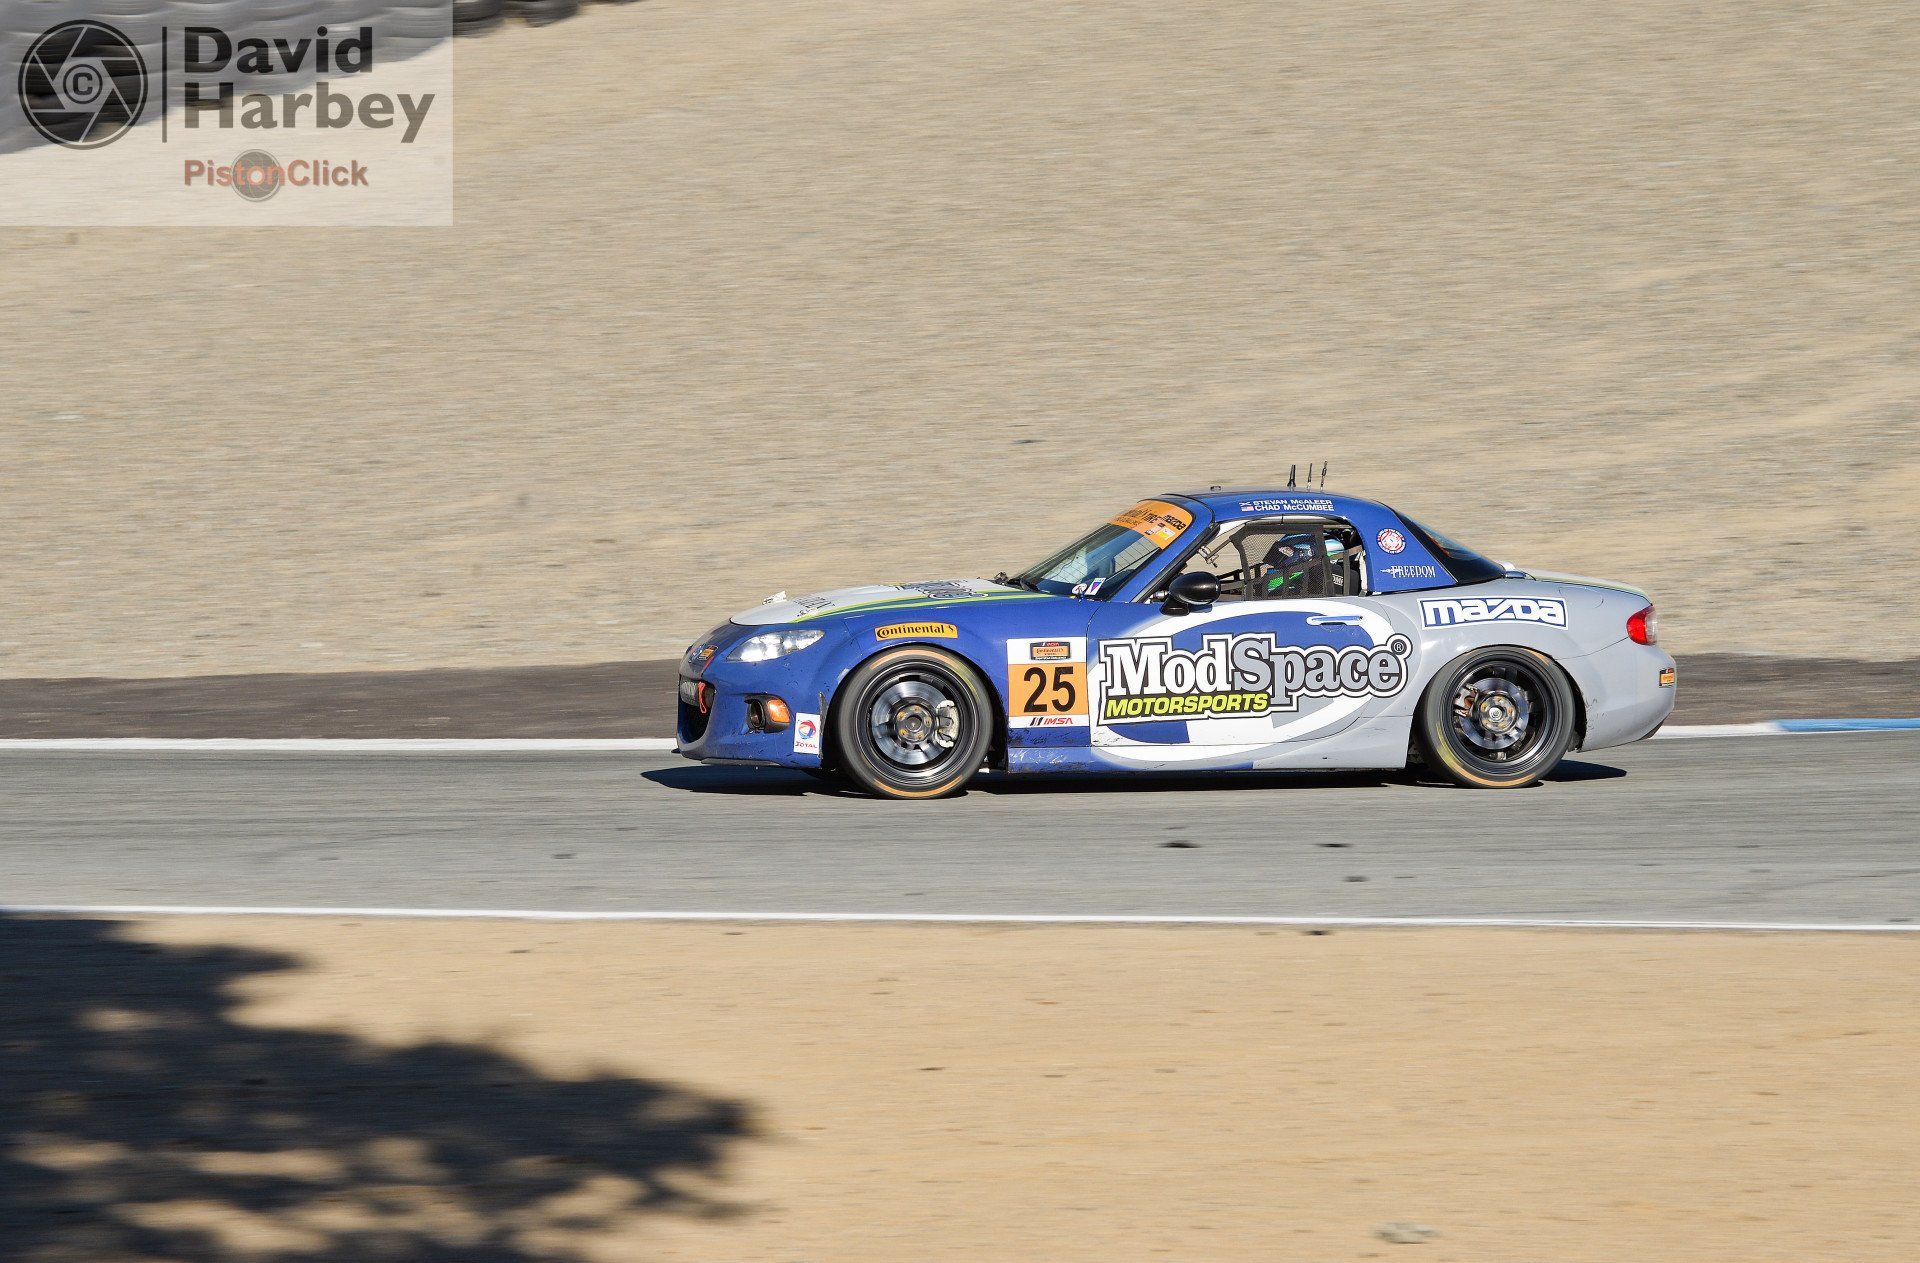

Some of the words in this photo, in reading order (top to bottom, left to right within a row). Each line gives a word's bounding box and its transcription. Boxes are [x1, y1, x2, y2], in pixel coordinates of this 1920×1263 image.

[1391, 565, 1436, 578] FREEDOM
[876, 624, 945, 639] Continental
[1024, 666, 1076, 712] 25
[1106, 692, 1269, 717] MOTORSPORTS
[1043, 717, 1073, 725] IMSA
